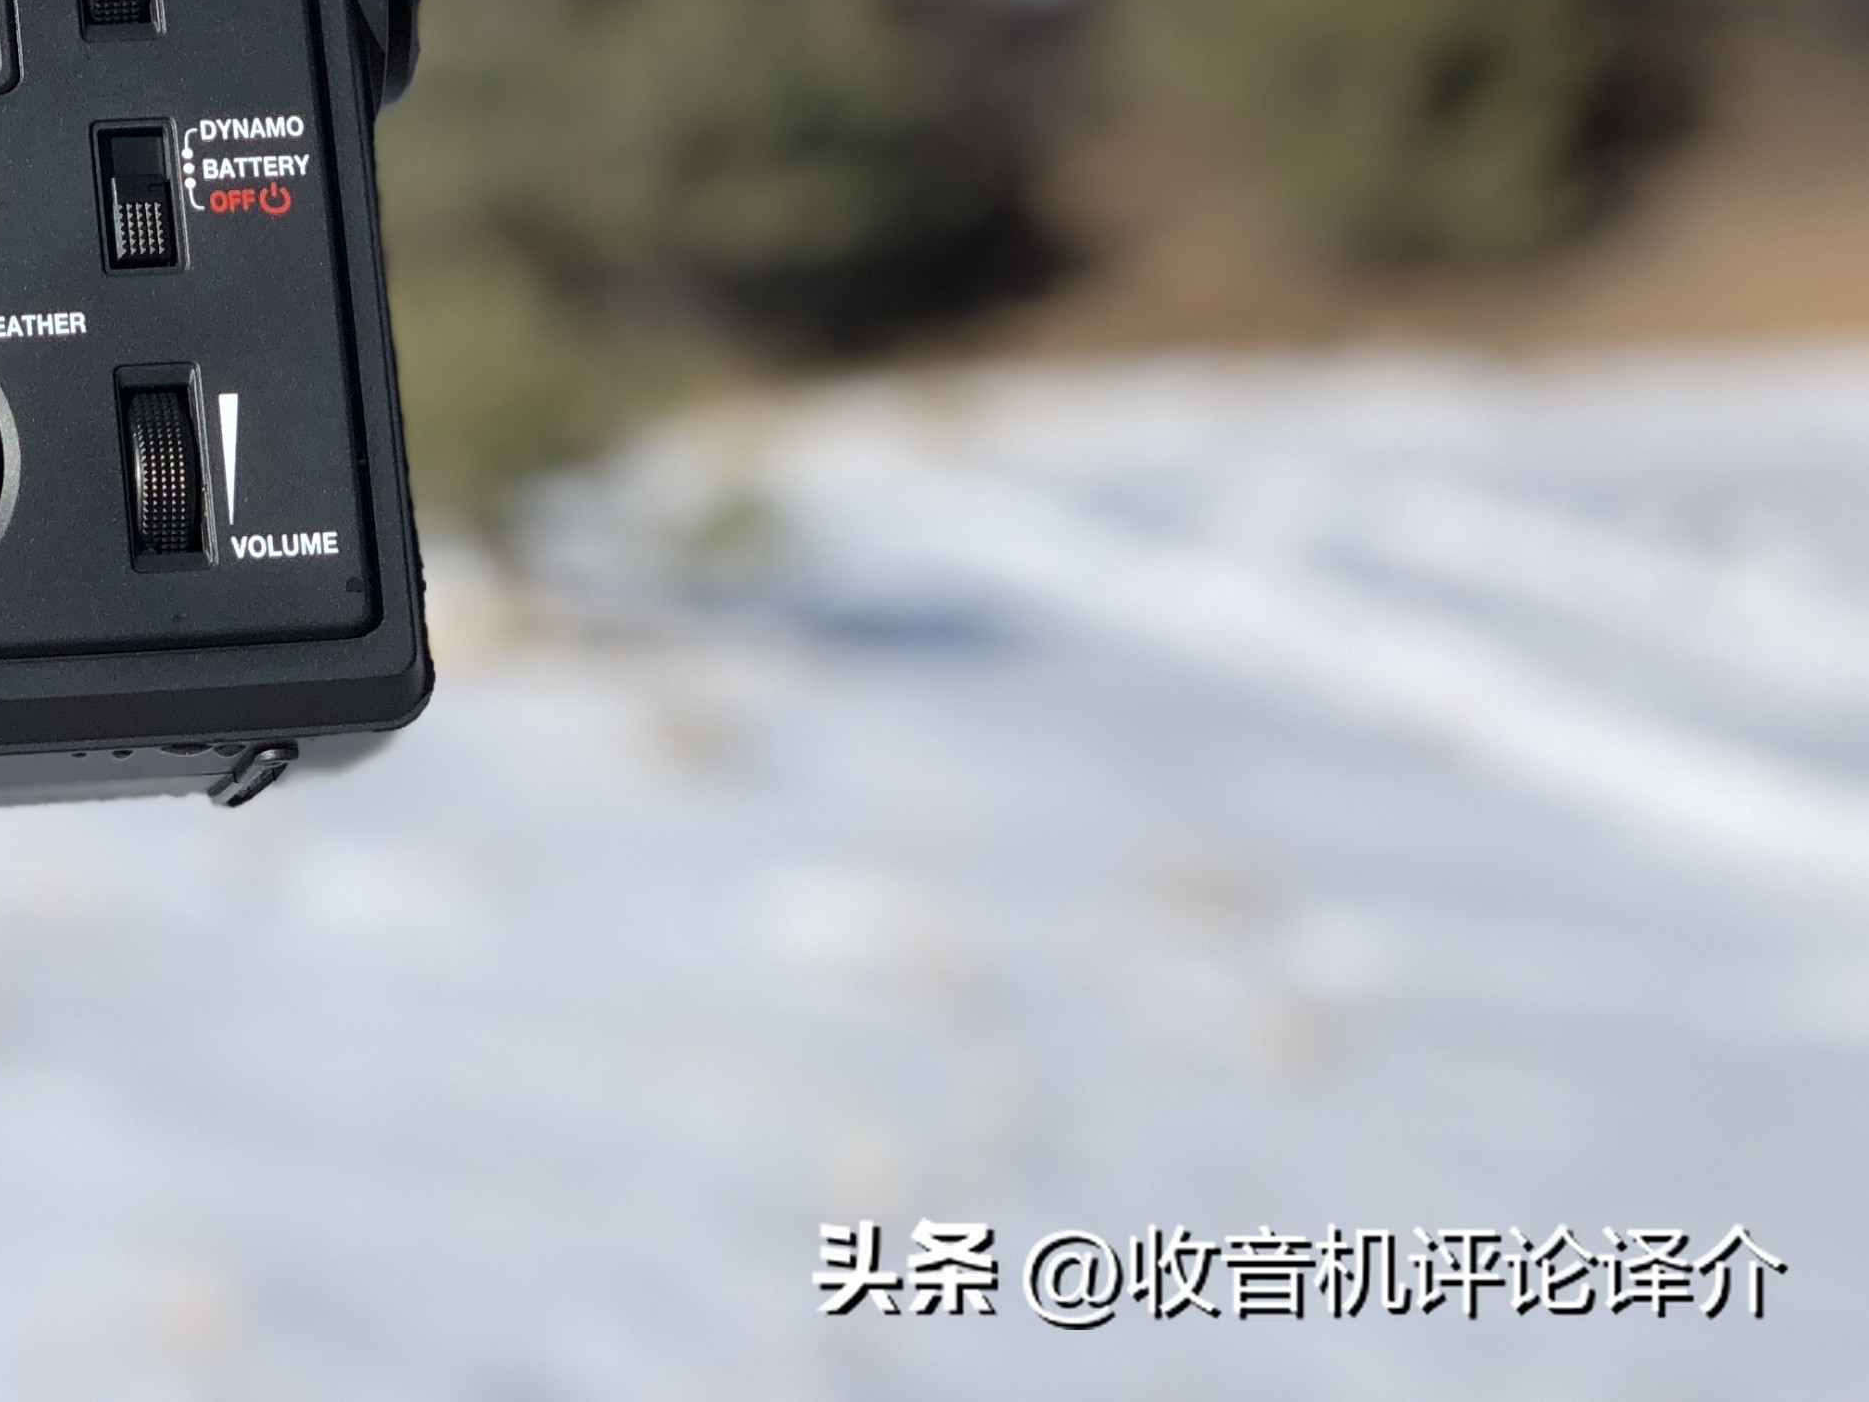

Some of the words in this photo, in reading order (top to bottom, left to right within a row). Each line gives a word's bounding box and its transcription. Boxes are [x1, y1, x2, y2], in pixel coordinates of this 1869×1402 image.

[199, 116, 304, 140] DYNAMO
[203, 154, 309, 179] BATTERY
[210, 189, 255, 213] OFF
[231, 531, 339, 559] VOLUME
